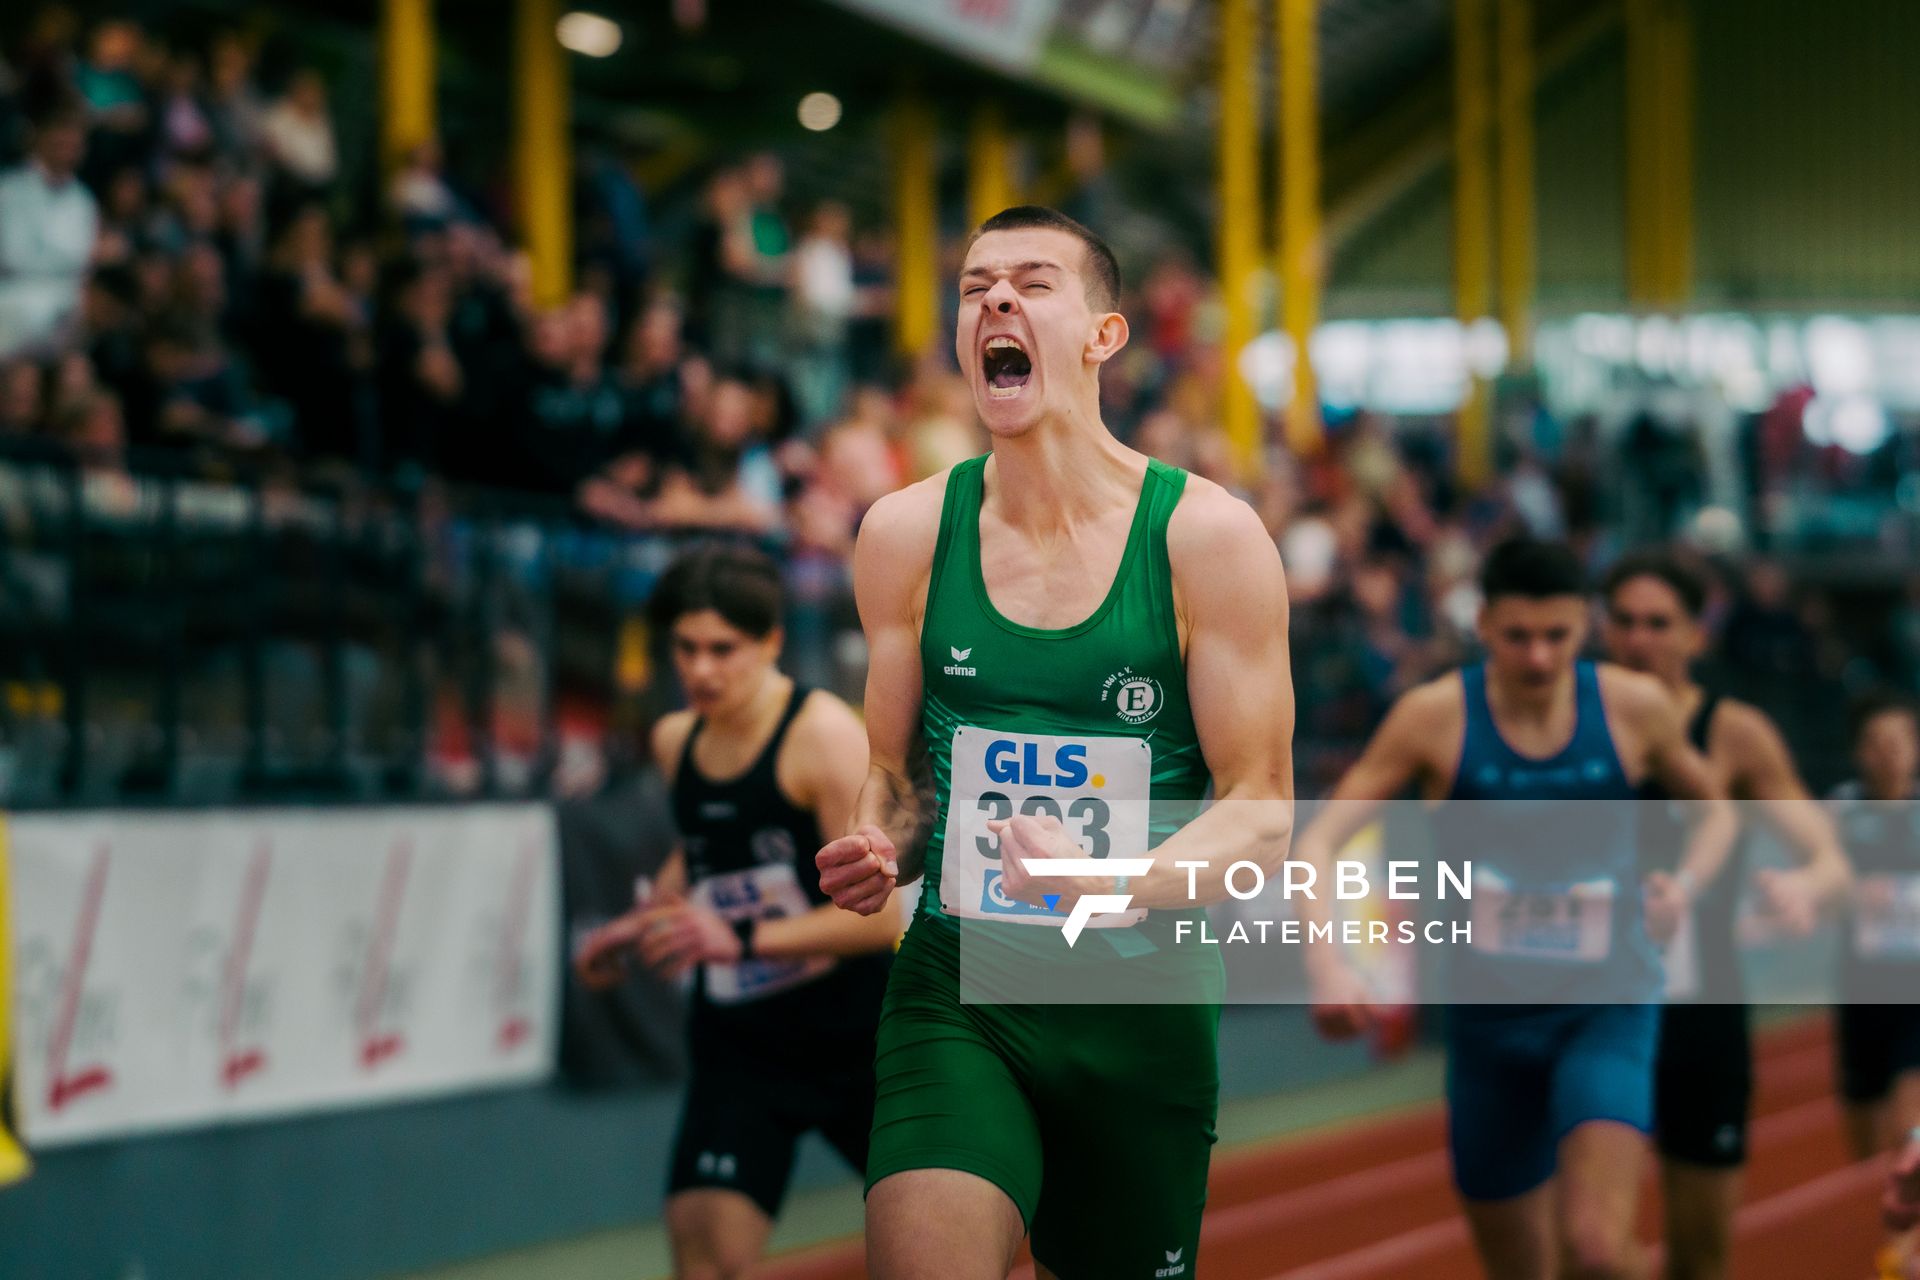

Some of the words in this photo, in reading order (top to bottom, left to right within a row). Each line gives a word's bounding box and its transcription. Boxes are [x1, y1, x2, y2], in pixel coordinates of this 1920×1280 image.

[943, 664, 977, 677] erima
[1124, 686, 1146, 712] E
[1155, 1262, 1185, 1278] erima
